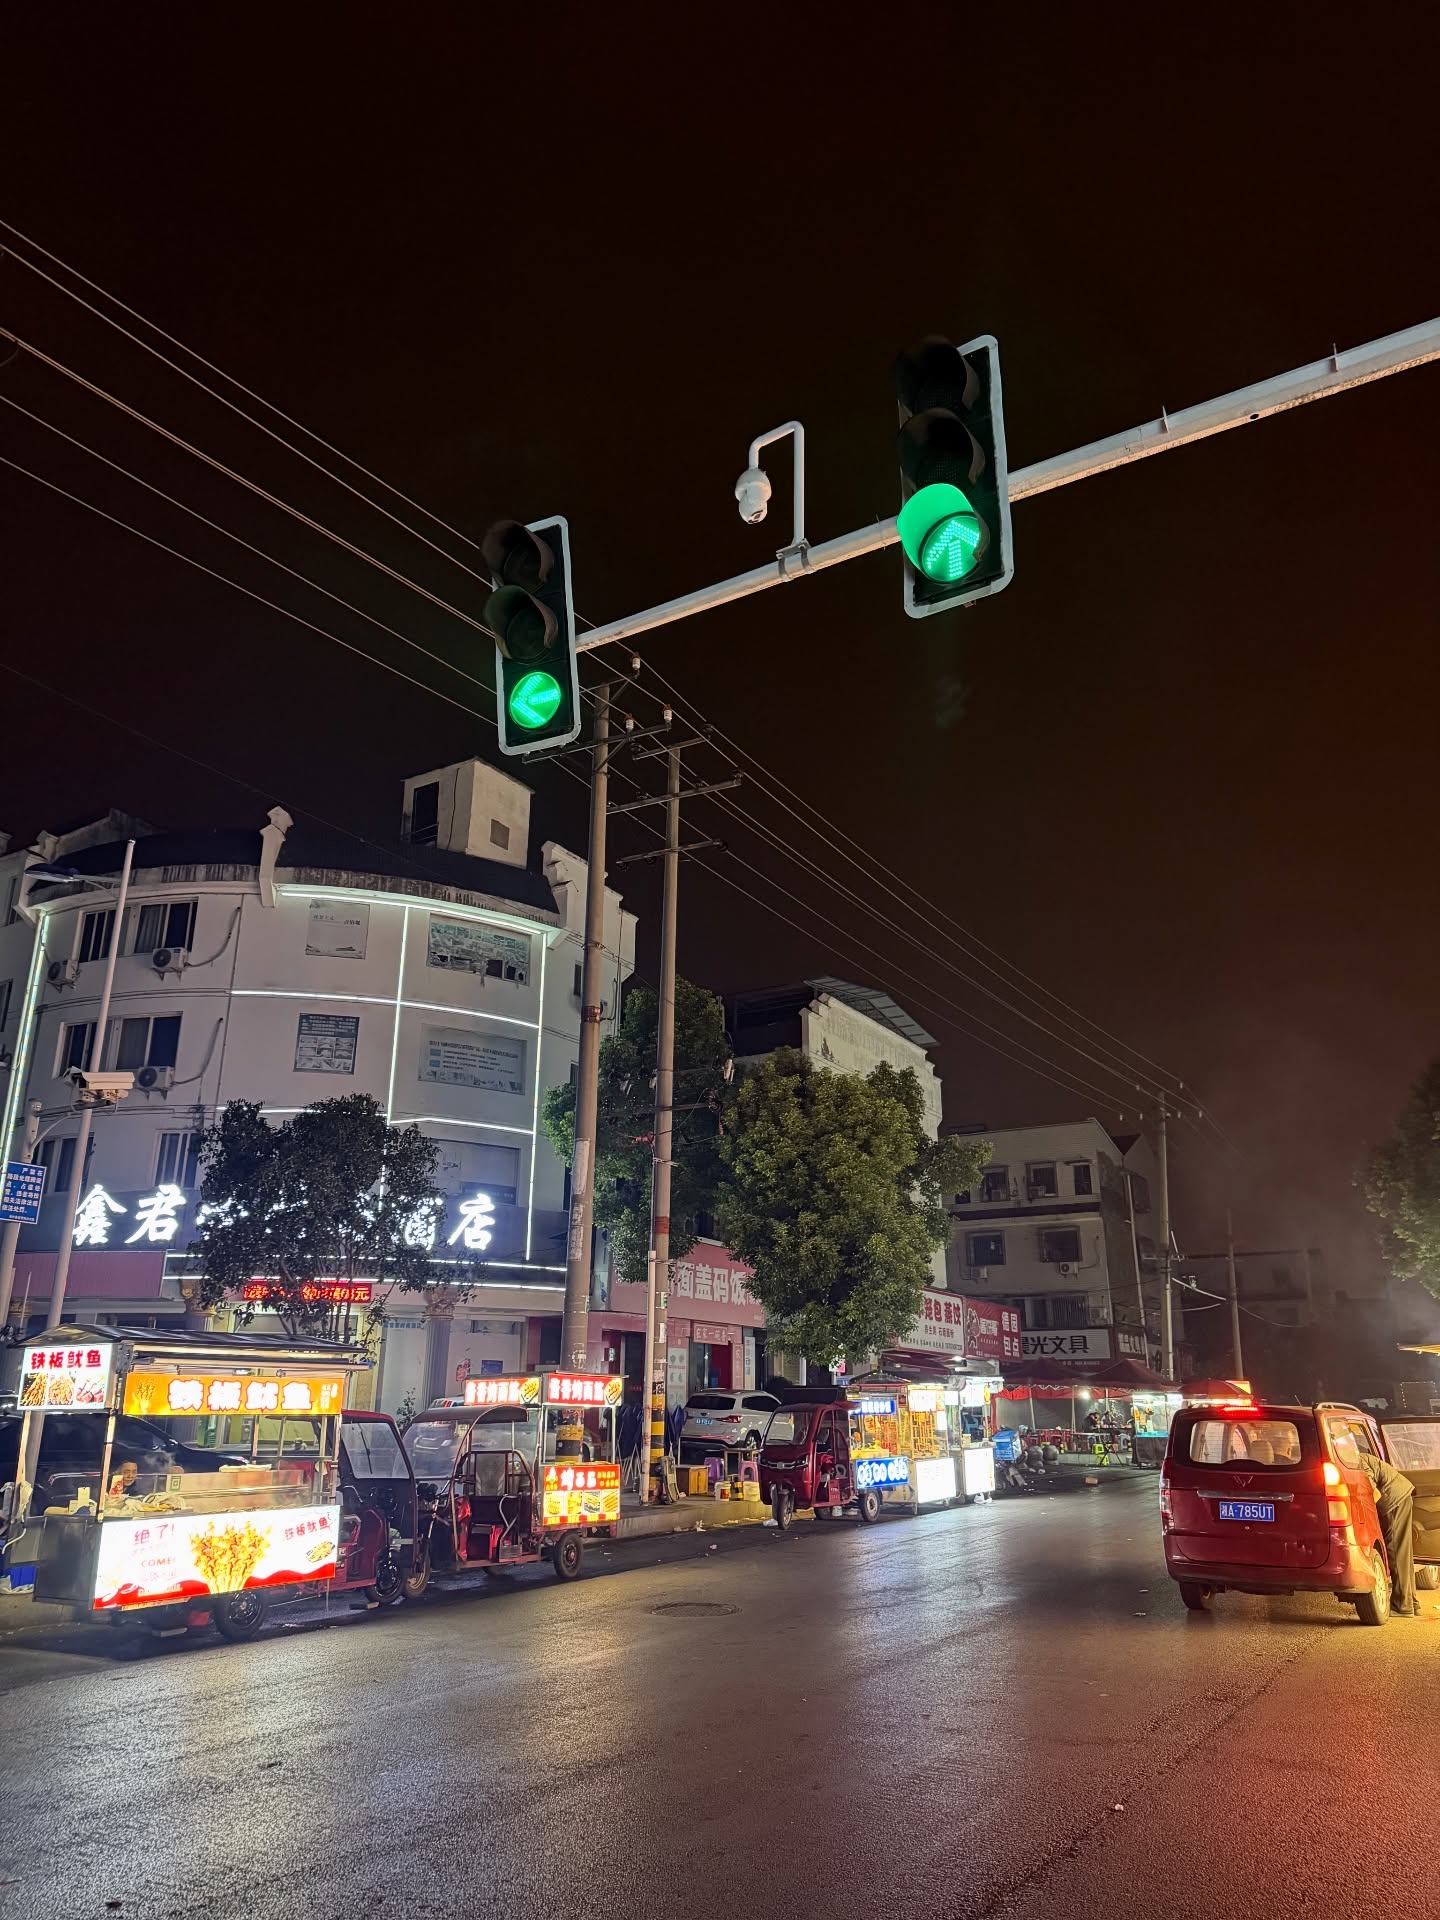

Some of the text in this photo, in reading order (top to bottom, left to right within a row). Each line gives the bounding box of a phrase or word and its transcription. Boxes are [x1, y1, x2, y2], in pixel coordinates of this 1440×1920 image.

[73, 1184, 186, 1246] 鑫君
[31, 1350, 101, 1369] 铁板鱿鱼
